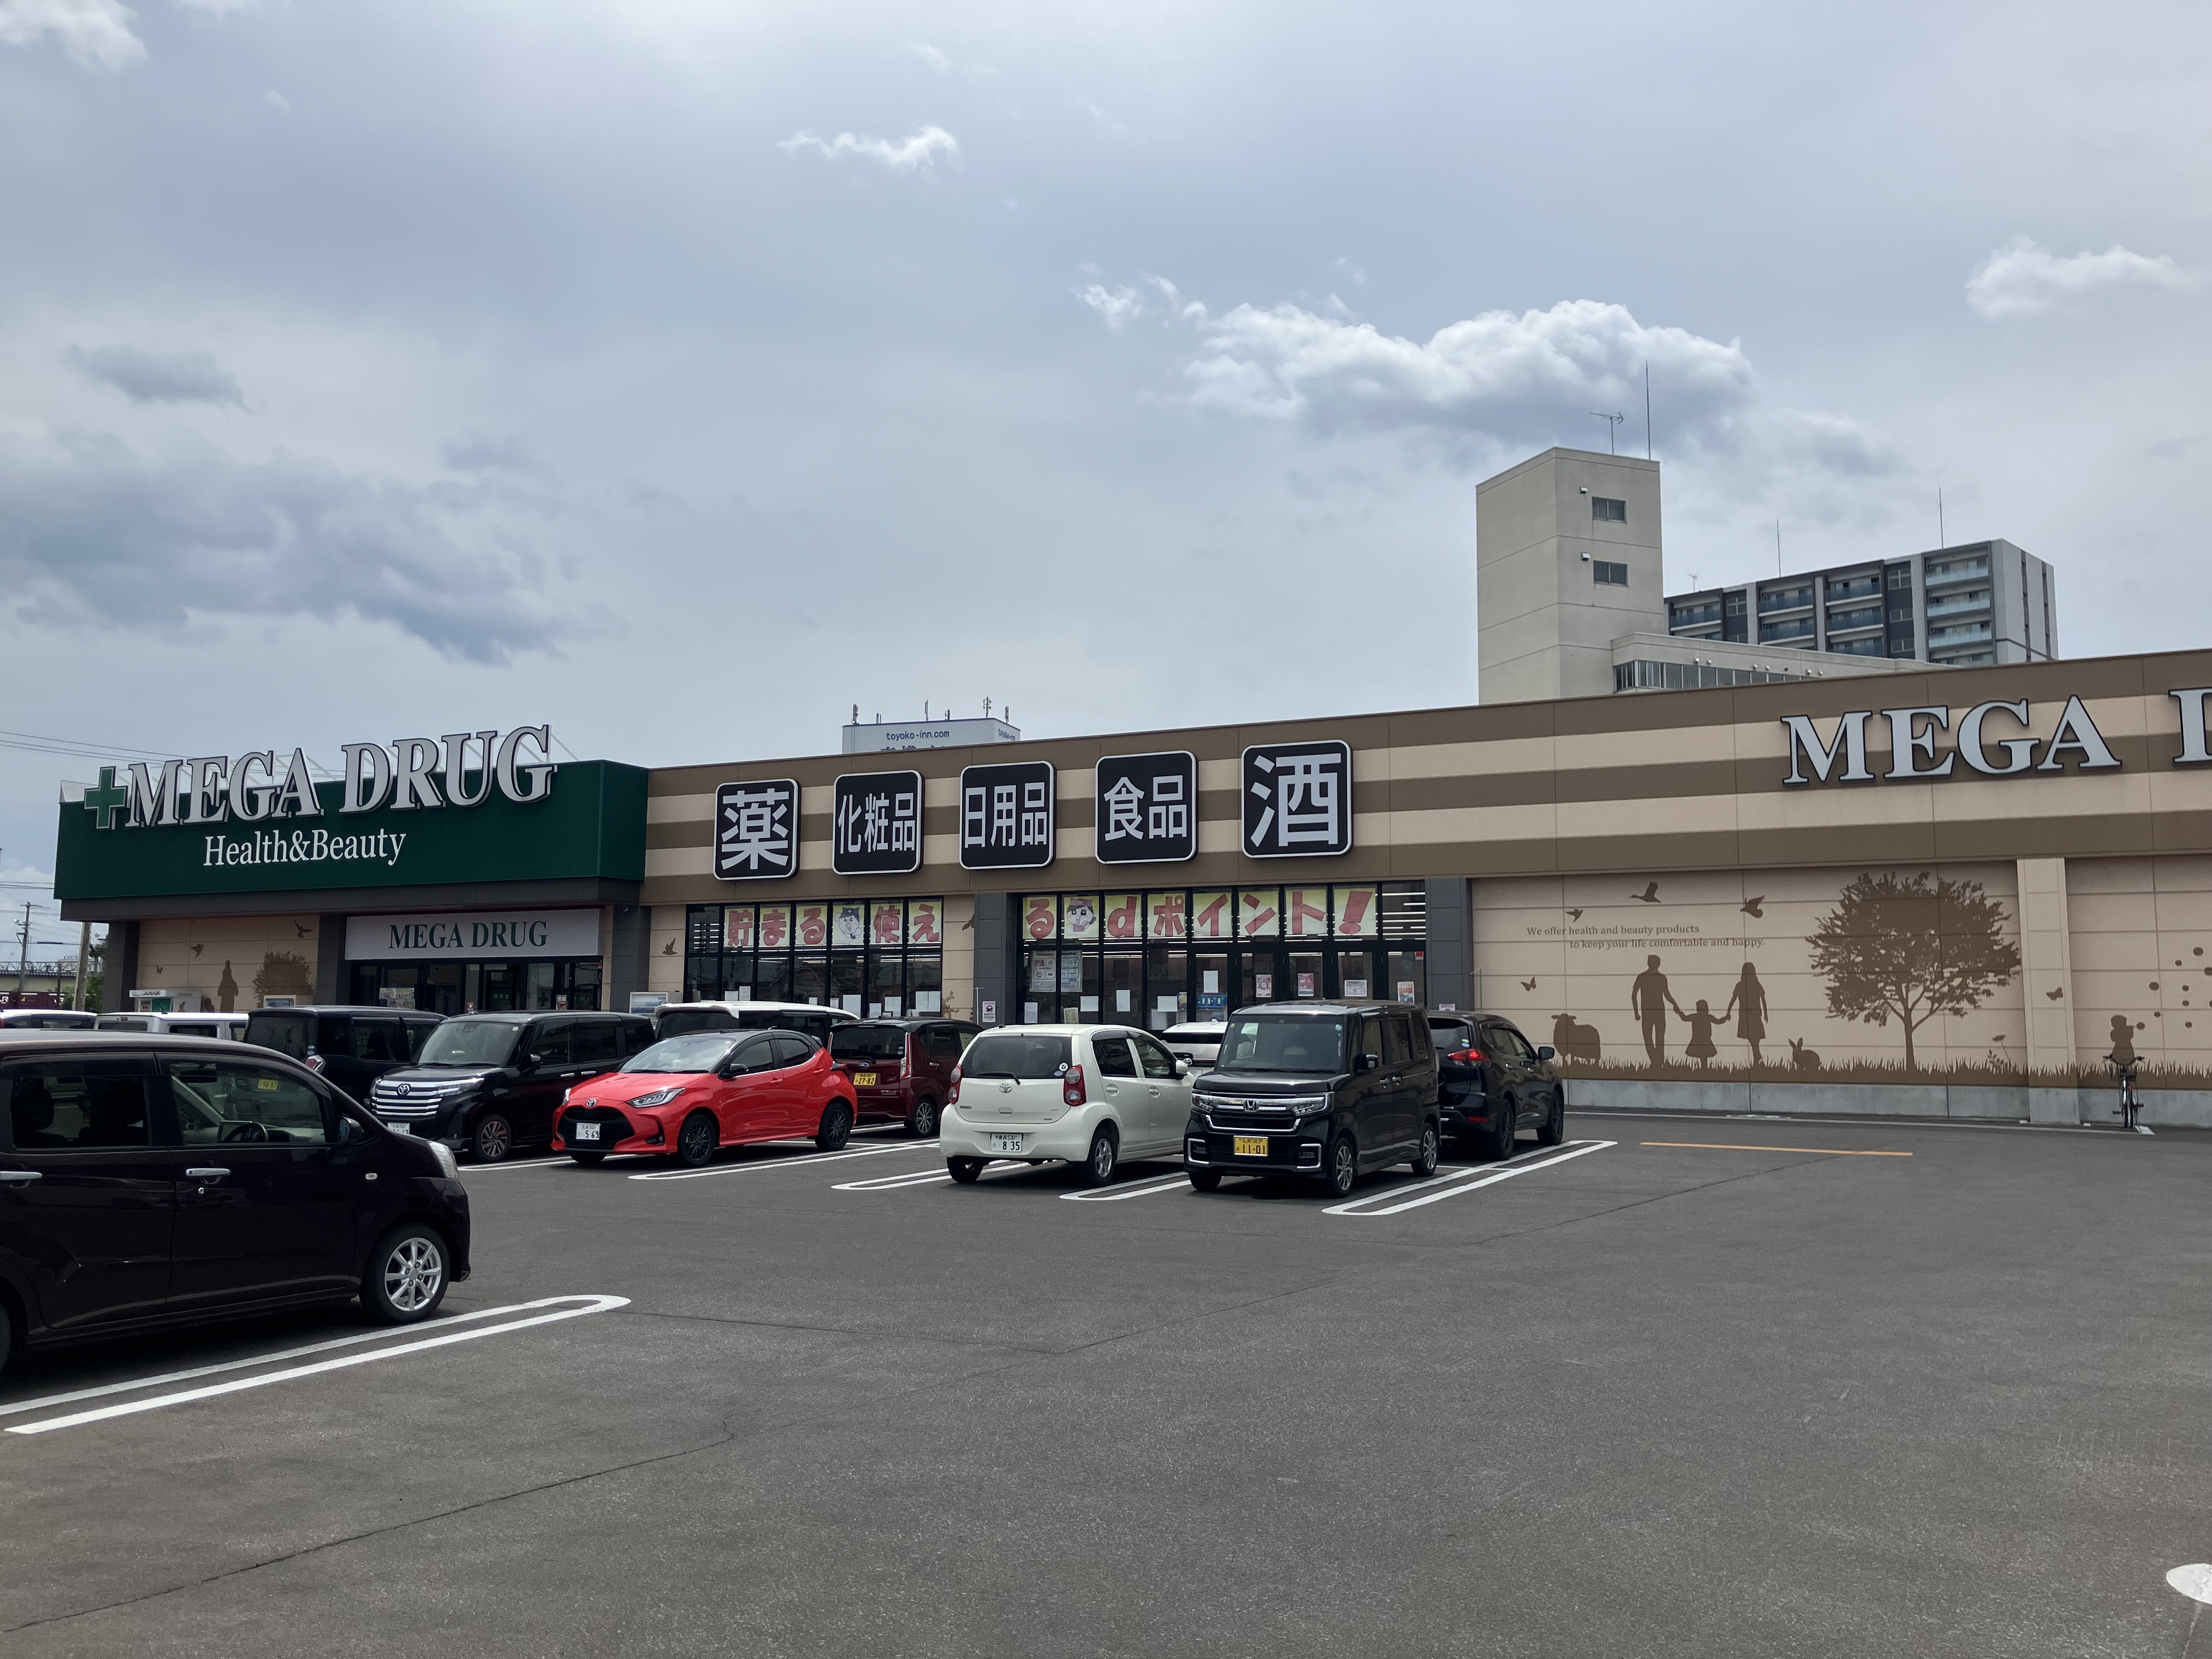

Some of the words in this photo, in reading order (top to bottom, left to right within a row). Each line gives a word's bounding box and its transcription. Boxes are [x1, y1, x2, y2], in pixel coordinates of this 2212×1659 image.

[886, 730, 950, 741] toyoko-inn.com
[1780, 695, 2123, 785] MEGA
[125, 747, 324, 829] MEGA
[338, 724, 557, 814] DRUG
[1103, 774, 1188, 842] 食品
[1250, 752, 1342, 848] 酒
[720, 788, 790, 871] 薬
[837, 792, 916, 855] 化粧品
[964, 781, 1048, 849] 日用品
[203, 828, 407, 867] Health&Beauty
[388, 923, 464, 949] MEGA
[470, 920, 549, 947] DRUG
[727, 907, 826, 947] 貯まる
[1527, 927, 1542, 935] We
[1544, 927, 1566, 935] offer
[1569, 926, 1598, 935] health
[1600, 925, 1618, 934] and
[1621, 925, 1654, 936] beauty
[1656, 924, 1700, 936] products
[1570, 940, 1579, 948] to
[1582, 939, 1604, 950] keep
[1606, 940, 1629, 950] your
[1632, 939, 1646, 948] life
[1649, 938, 1708, 947] comfortable
[1711, 938, 1729, 946] and
[1732, 937, 1766, 949] happy.
